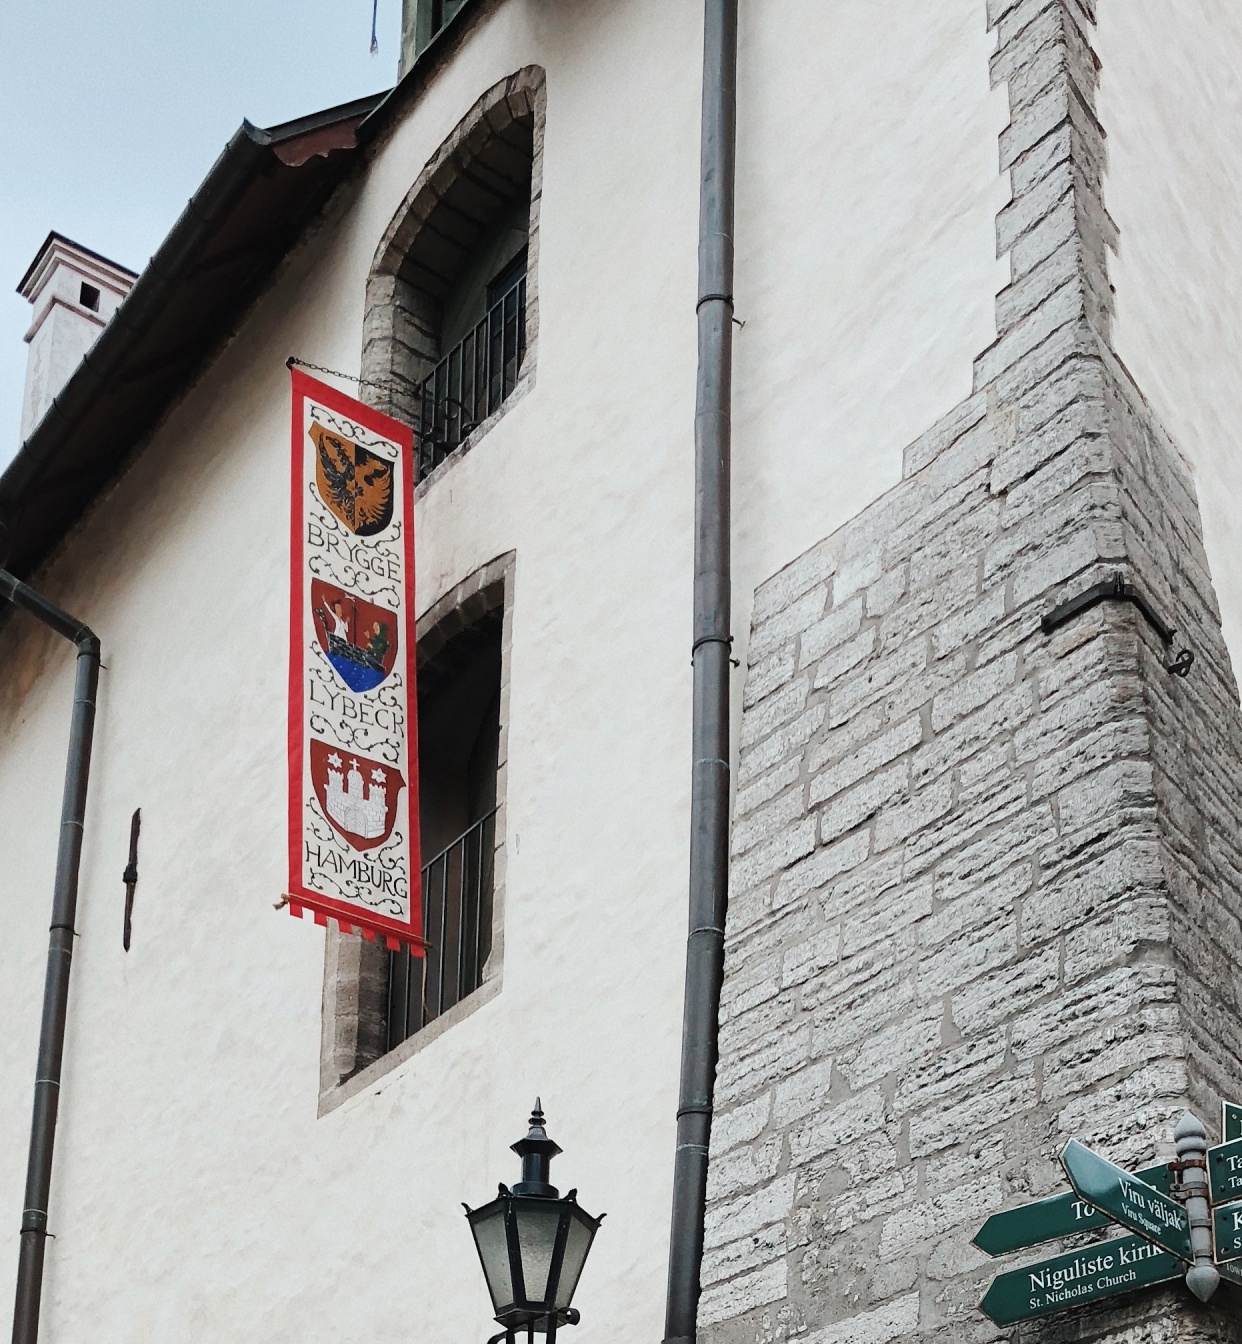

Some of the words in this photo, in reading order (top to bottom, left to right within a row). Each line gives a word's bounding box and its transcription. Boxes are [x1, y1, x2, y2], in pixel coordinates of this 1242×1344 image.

[307, 522, 402, 584] BRYGGE
[310, 679, 405, 738] LYBECK
[305, 840, 408, 899] HAMBURG
[1118, 1177, 1145, 1209] Viru
[1148, 1197, 1183, 1231] väljak
[1121, 1202, 1138, 1222] Viru
[1138, 1216, 1162, 1236] Square
[1029, 1254, 1114, 1293] Niguliste
[1118, 1241, 1165, 1266] kirik
[1029, 1298, 1044, 1310] St.
[1046, 1282, 1094, 1305] Nicholas
[1096, 1269, 1137, 1289] Church
